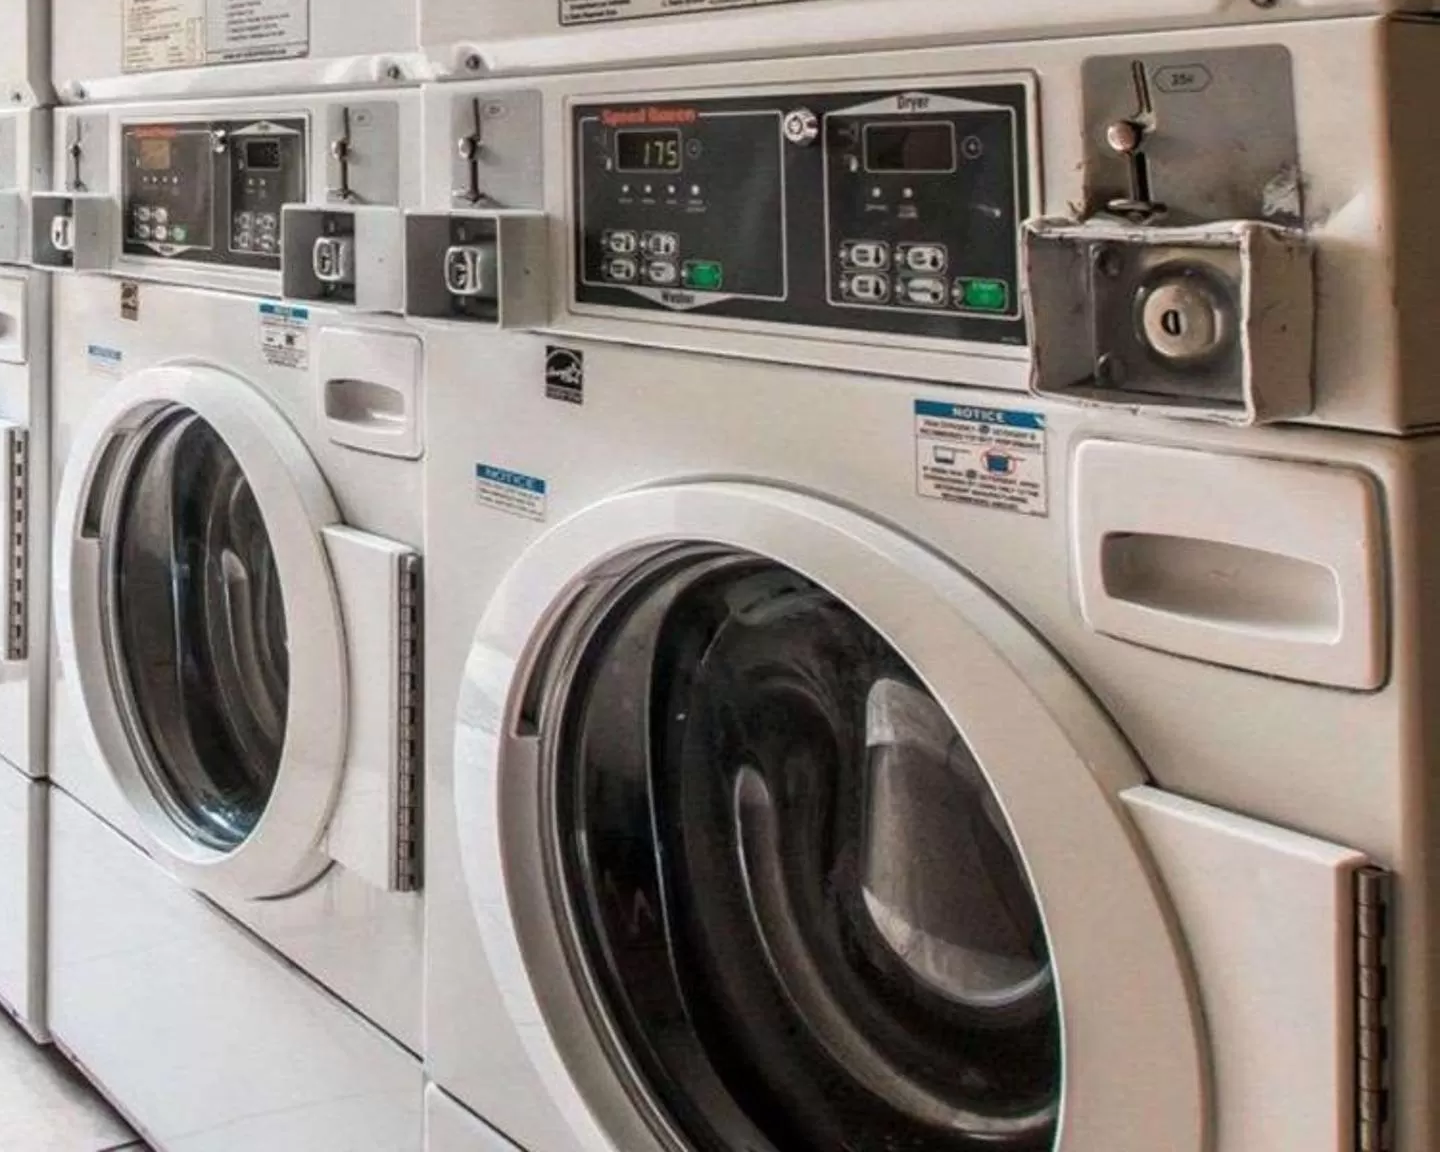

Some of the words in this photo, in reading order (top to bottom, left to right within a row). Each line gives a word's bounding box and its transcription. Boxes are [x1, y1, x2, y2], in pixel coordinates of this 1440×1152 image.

[896, 95, 930, 112] Dryer
[643, 140, 678, 166] 175
[952, 406, 1006, 423] NOTICE
